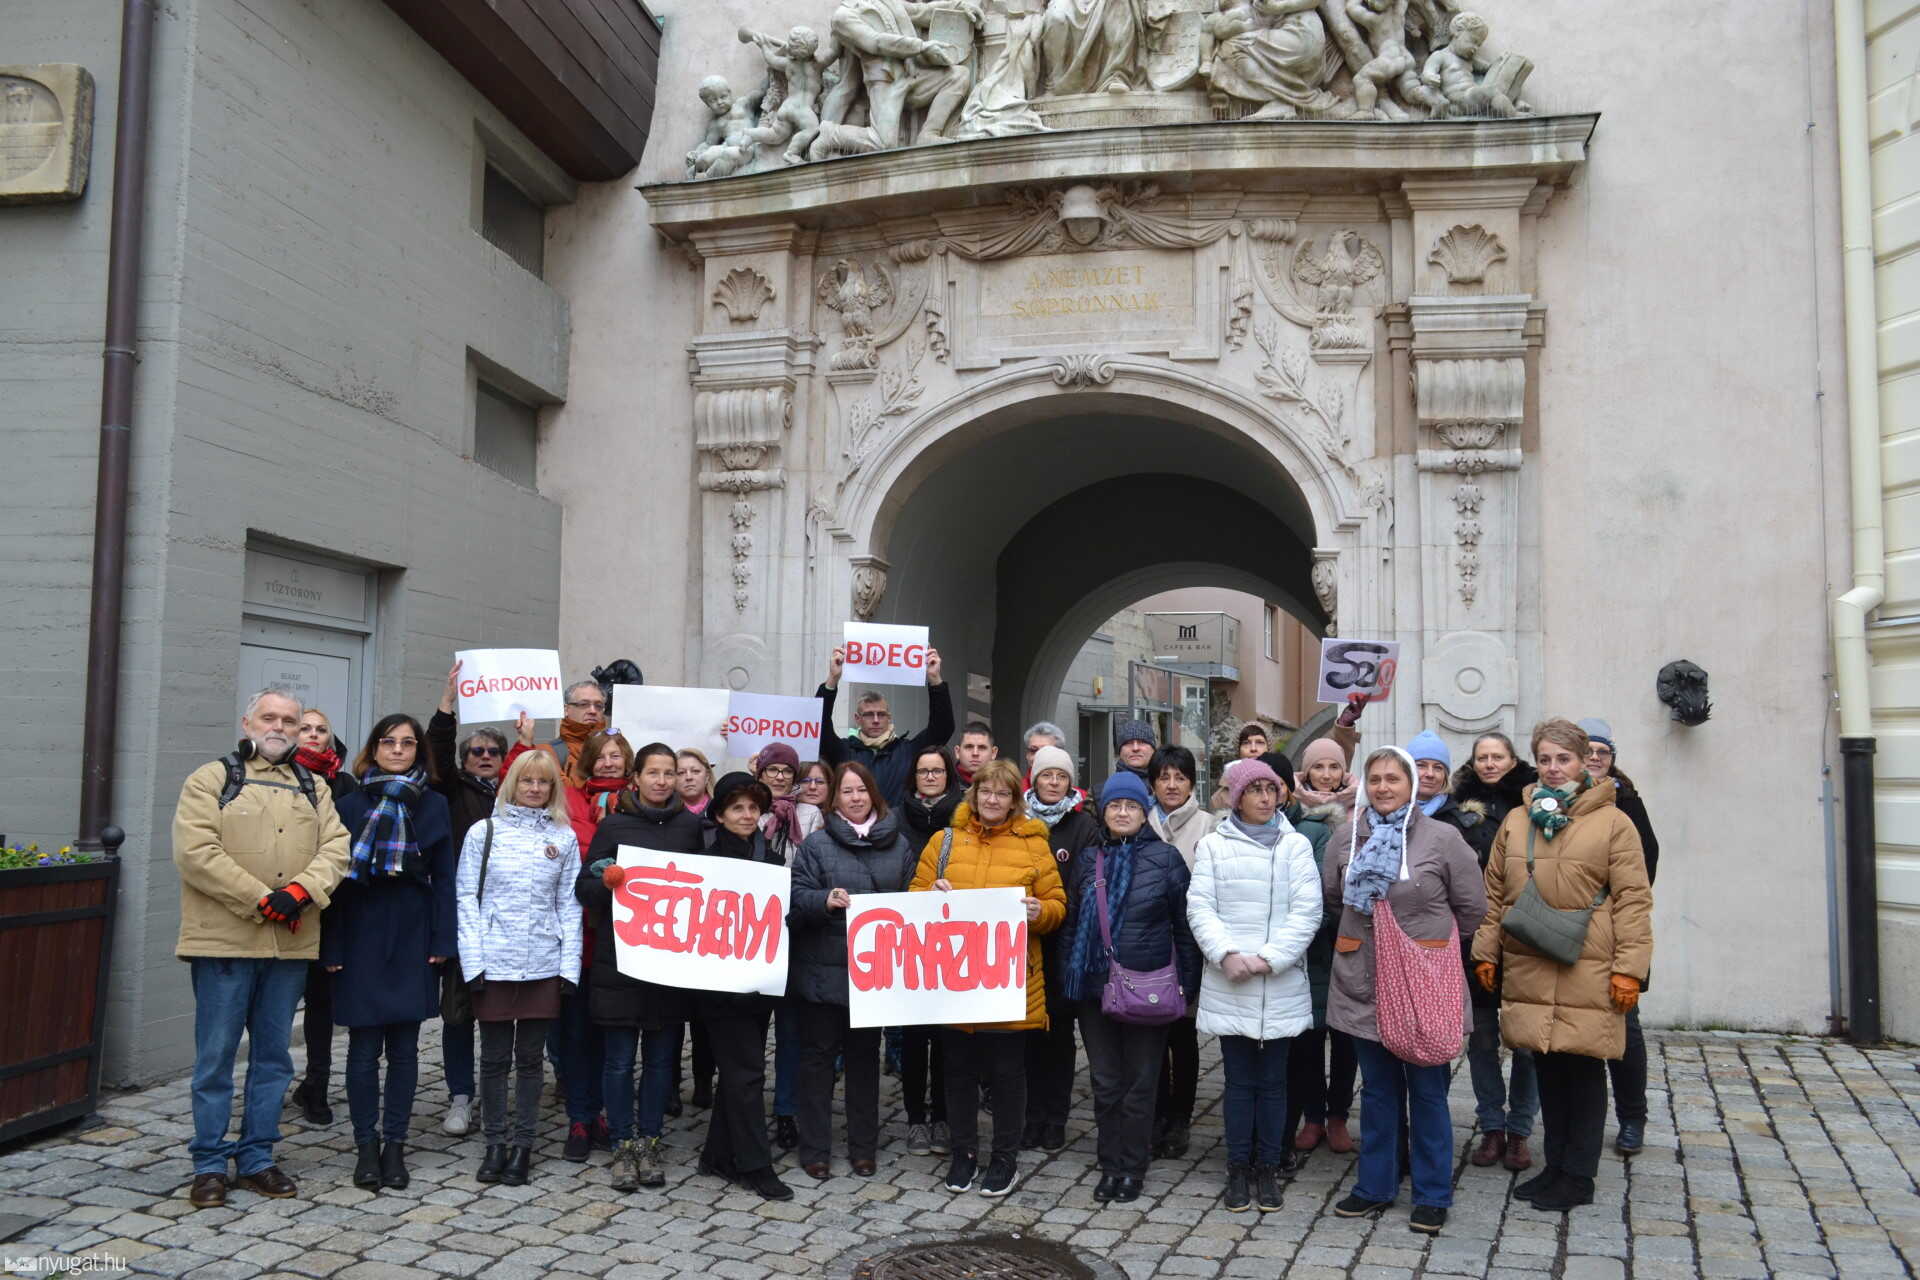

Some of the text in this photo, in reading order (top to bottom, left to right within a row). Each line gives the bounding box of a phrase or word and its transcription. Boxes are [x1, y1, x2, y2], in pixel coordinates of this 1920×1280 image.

[1025, 265, 1145, 291] A NEMZET
[1010, 292, 1161, 319] SOPRONNAK
[846, 641, 923, 669] BDEG
[460, 675, 559, 698] GÁRDONYI
[728, 714, 820, 740] SOPRON
